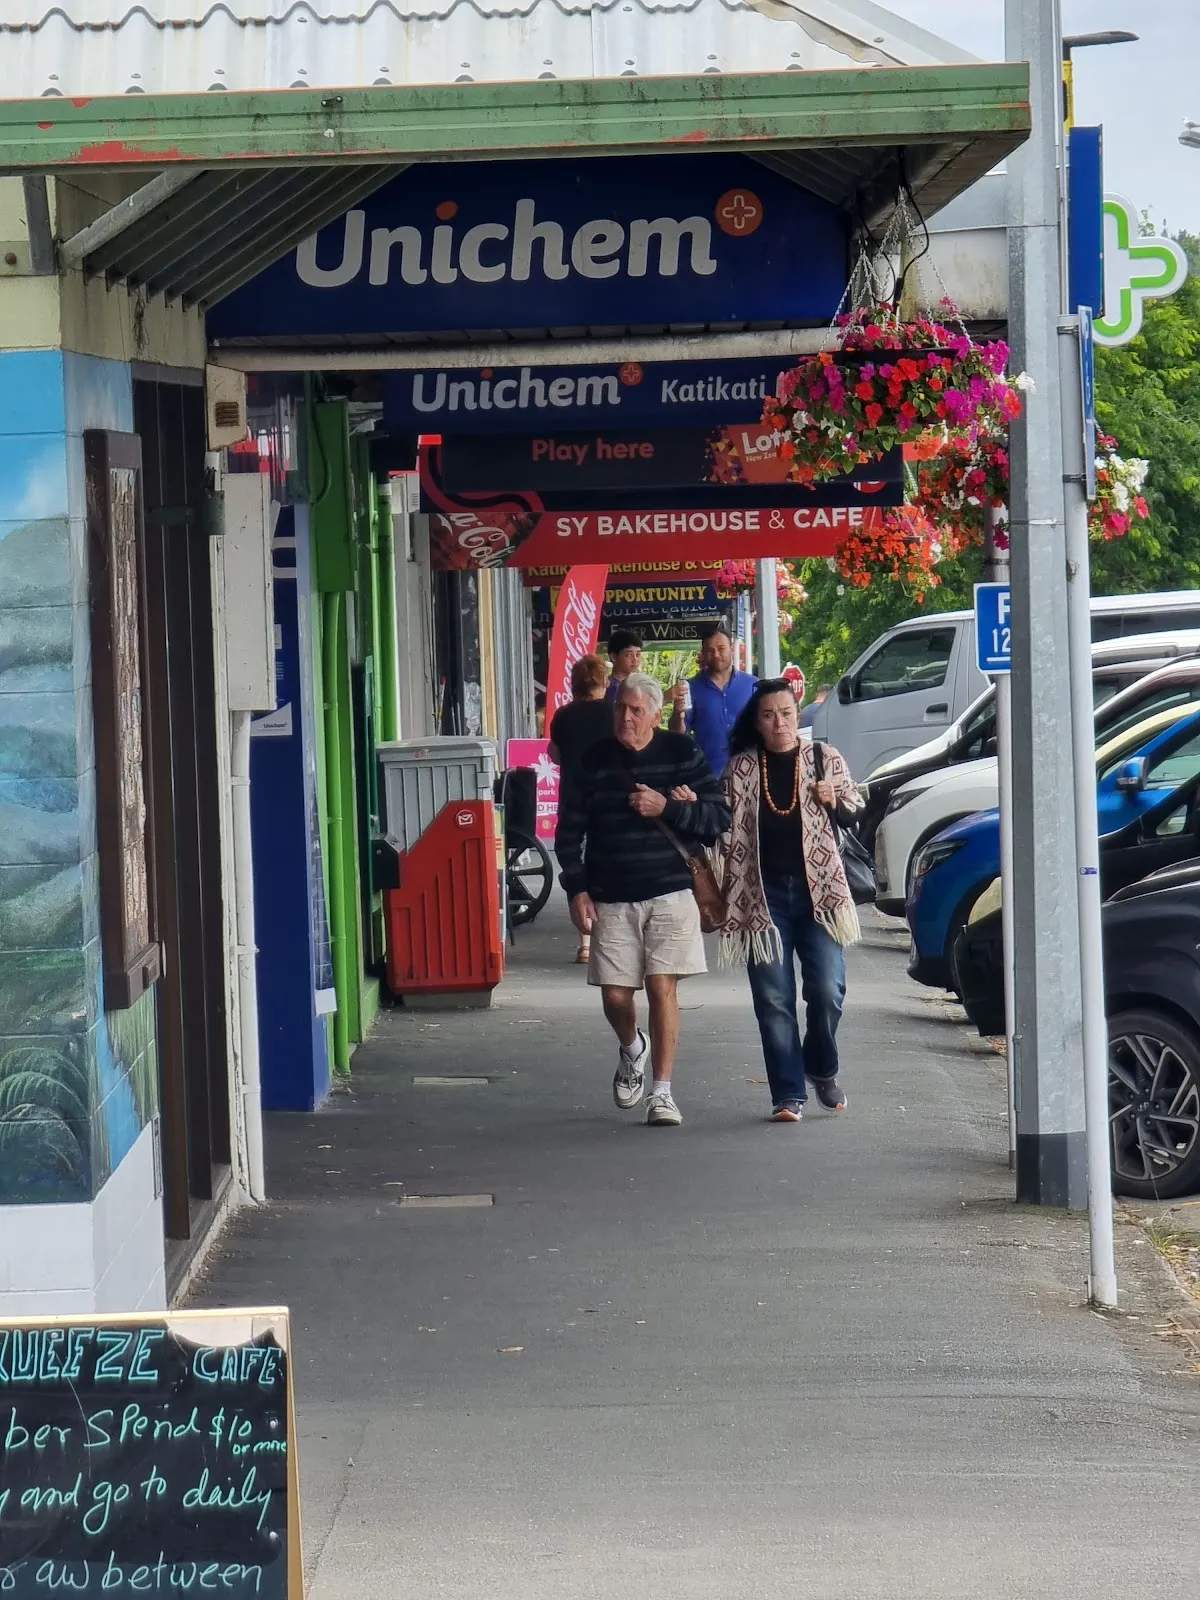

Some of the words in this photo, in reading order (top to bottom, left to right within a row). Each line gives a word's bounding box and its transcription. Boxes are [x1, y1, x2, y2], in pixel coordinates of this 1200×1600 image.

[296, 199, 717, 288] Unichem
[411, 367, 621, 413] Unichem
[661, 374, 767, 404] Katikati
[531, 440, 589, 466] Play
[596, 438, 655, 460] here
[741, 428, 793, 455] Lot
[557, 517, 588, 537] SY
[598, 510, 761, 535] BAKEHOUSE
[768, 510, 785, 529] &
[792, 507, 863, 528] CAFE
[605, 586, 707, 603] PPORTUNITY
[992, 628, 1011, 653] 12
[0, 1327, 166, 1381] UEEZE
[192, 1346, 282, 1384] CAFE
[5, 1406, 72, 1449] ber
[208, 1406, 252, 1448] $10
[20, 1472, 82, 1511] and
[82, 1481, 131, 1535] go
[140, 1465, 167, 1494] to
[182, 1465, 272, 1531] daily
[101, 1550, 262, 1593] between
